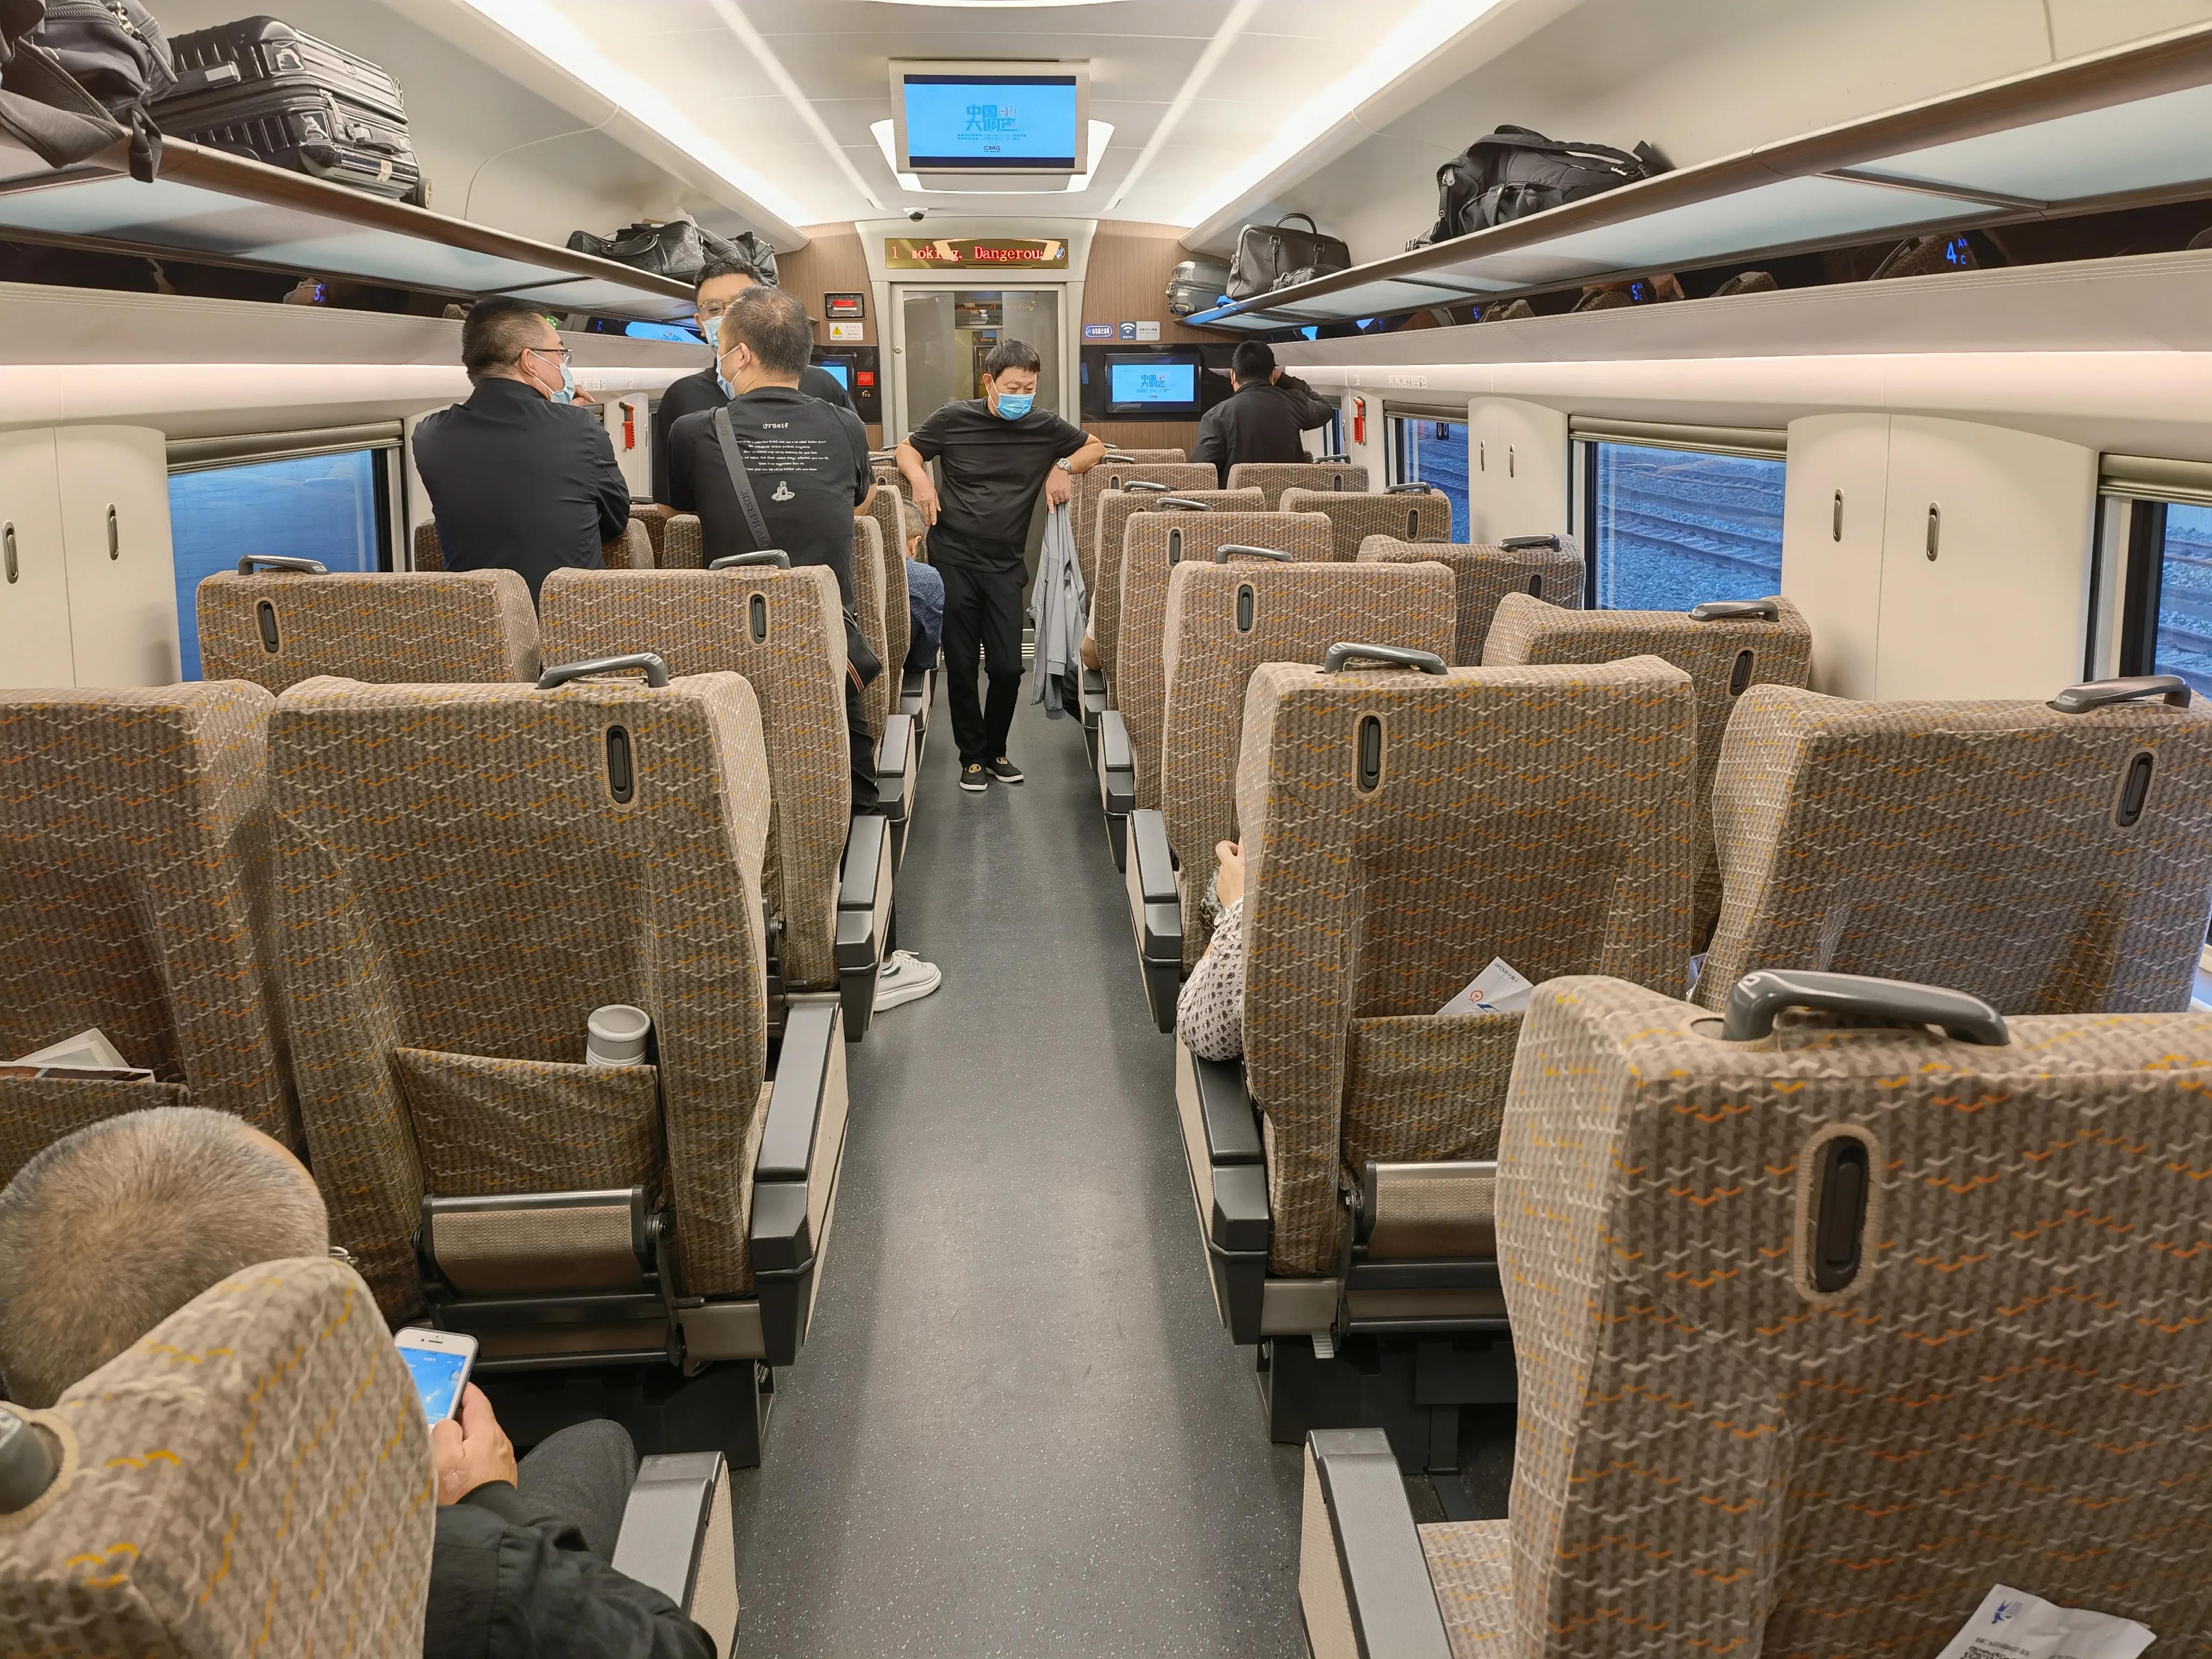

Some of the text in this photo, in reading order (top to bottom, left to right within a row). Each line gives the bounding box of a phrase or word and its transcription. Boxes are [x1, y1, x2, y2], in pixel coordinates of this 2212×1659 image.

[966, 104, 997, 118] 中国
[1946, 241, 1957, 264] 4
[1631, 285, 1638, 300] 5
[740, 490, 761, 528] JOSEPH
